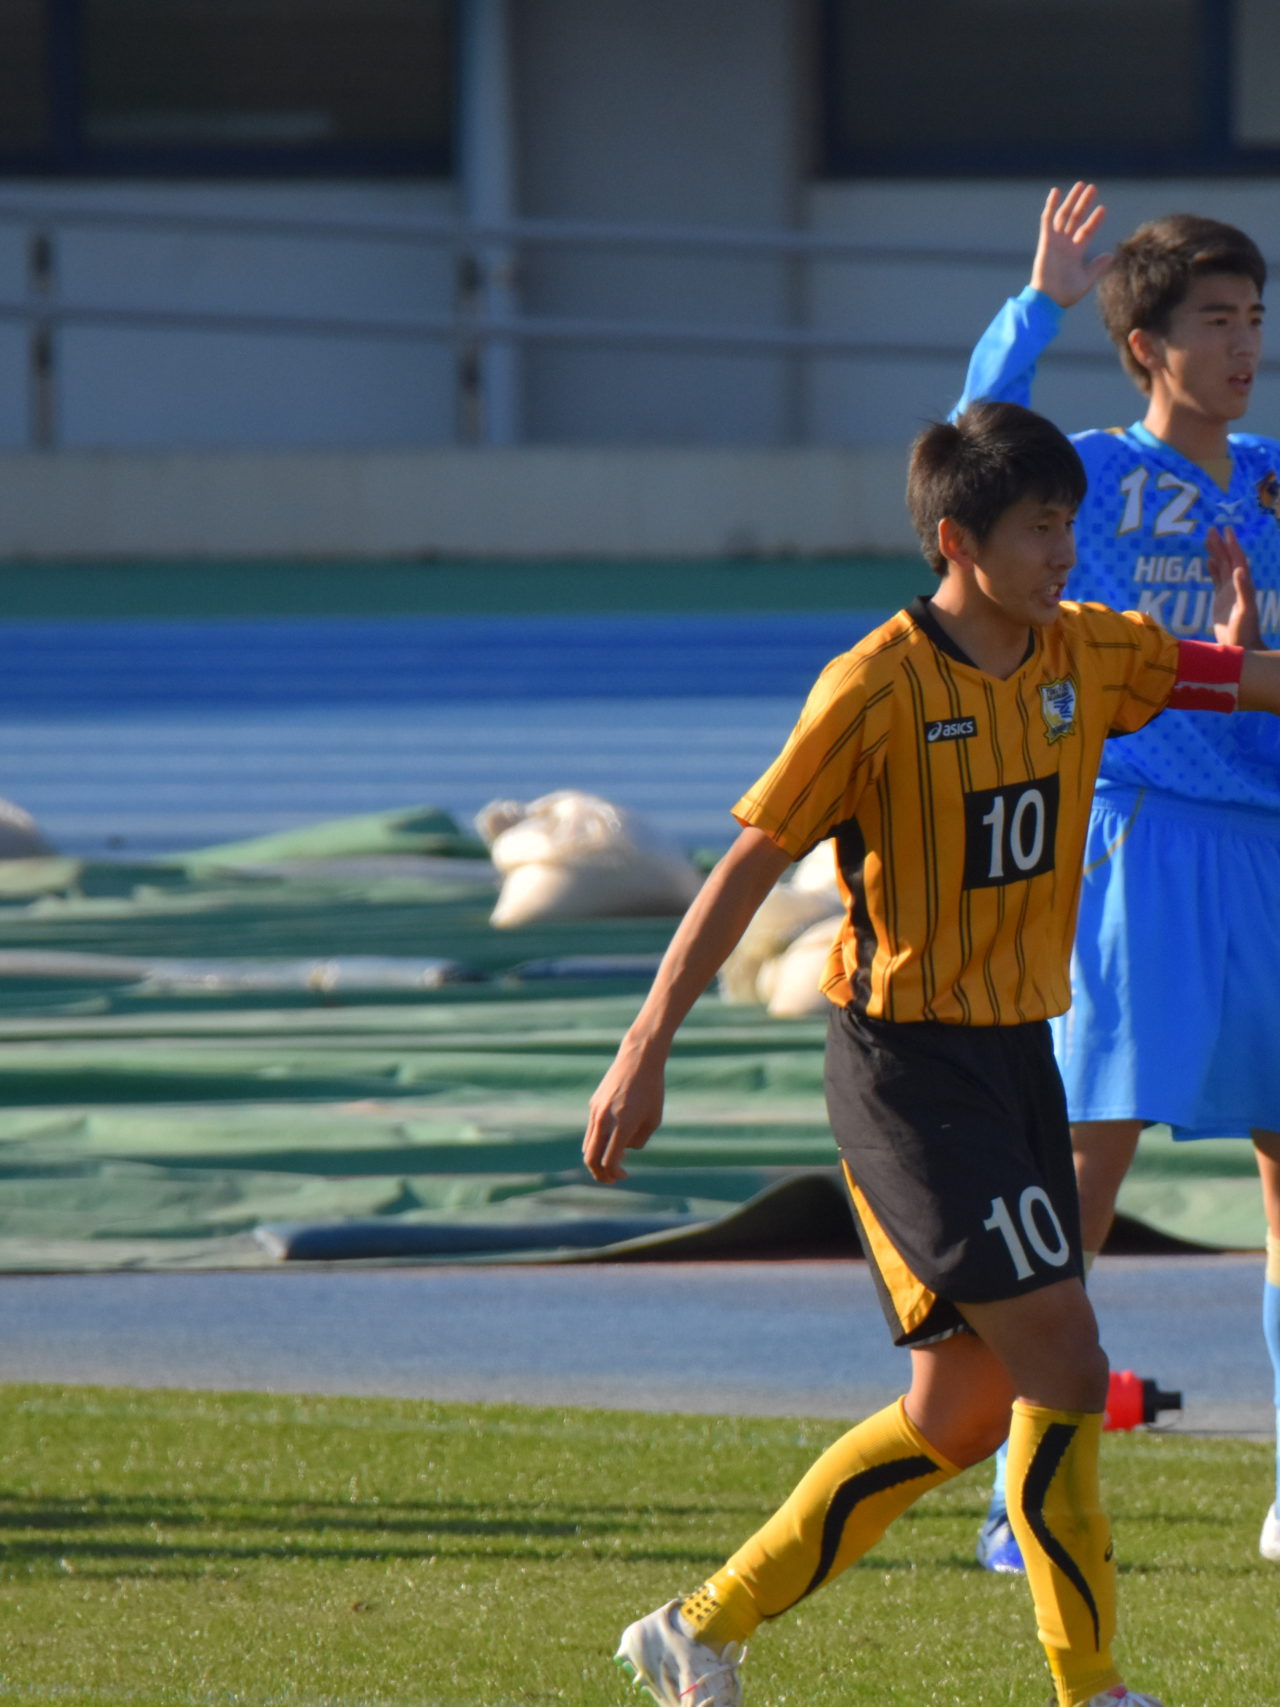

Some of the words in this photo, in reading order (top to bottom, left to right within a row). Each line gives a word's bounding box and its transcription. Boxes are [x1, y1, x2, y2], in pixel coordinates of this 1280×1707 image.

[1116, 465, 1200, 538] 12
[942, 721, 974, 737] asics
[982, 788, 1046, 879] 10
[983, 1185, 1070, 1280] 10
